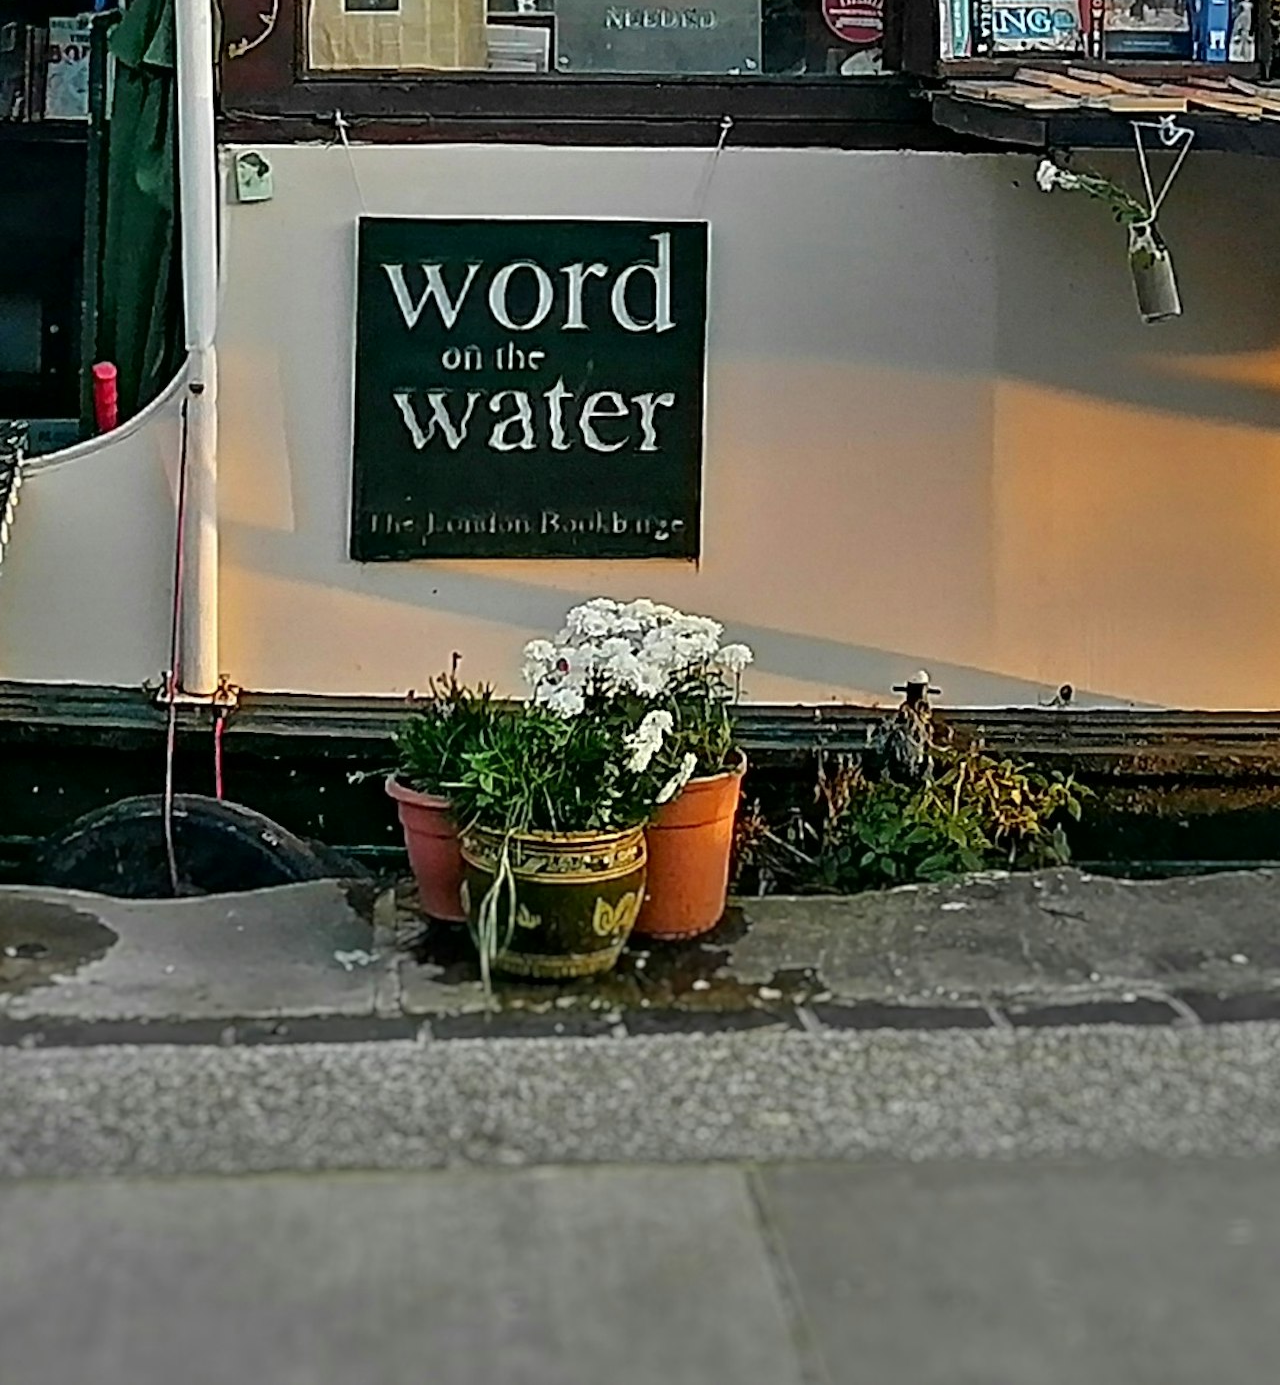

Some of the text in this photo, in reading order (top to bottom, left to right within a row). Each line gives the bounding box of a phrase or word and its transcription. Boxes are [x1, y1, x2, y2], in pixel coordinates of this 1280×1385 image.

[604, 6, 718, 30] NEEDED
[381, 232, 677, 333] word
[442, 341, 545, 370] on the
[393, 375, 676, 453] water
[371, 513, 414, 534] The
[426, 512, 531, 535] London
